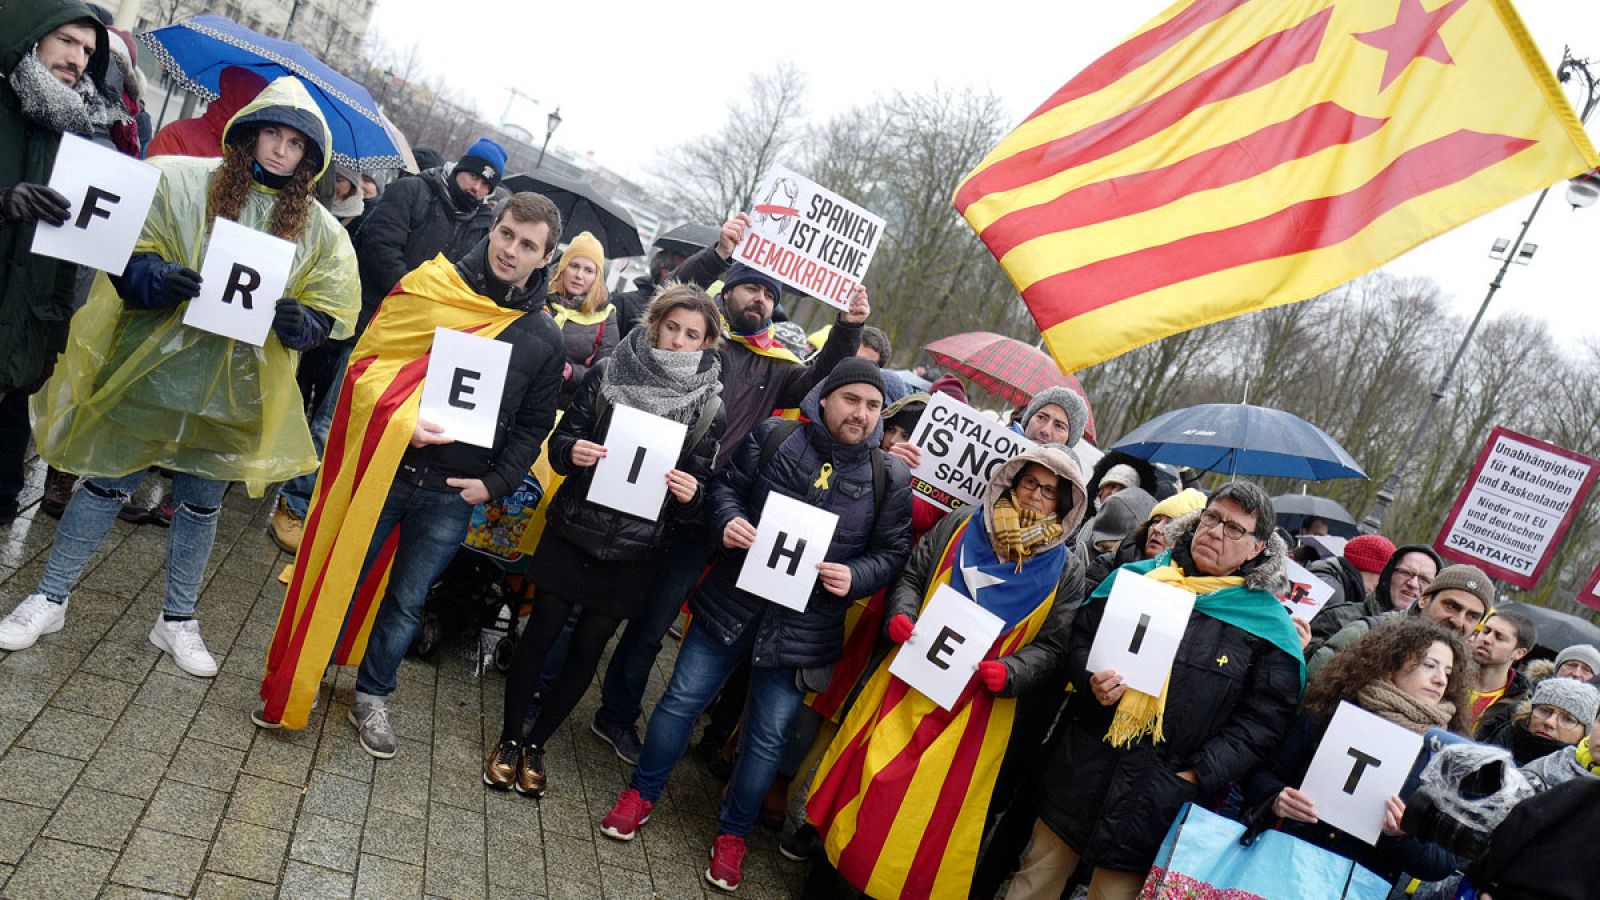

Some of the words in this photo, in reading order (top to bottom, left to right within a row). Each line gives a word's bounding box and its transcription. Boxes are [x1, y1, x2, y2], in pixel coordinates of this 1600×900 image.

[75, 186, 120, 229] F
[807, 194, 877, 248] SPANIEN
[741, 233, 857, 304] DEMOKRATIE!
[788, 220, 820, 253] IST
[817, 235, 867, 277] KEINE
[222, 263, 260, 309] R
[449, 367, 480, 409] E
[916, 423, 953, 457] IS
[932, 406, 1026, 458] CATALON
[627, 447, 646, 484] I
[1490, 459, 1508, 473] für
[1509, 467, 1573, 495] Katalonien
[1495, 443, 1585, 481] Unabhängigkeit
[911, 477, 949, 505] EEDOM
[1479, 475, 1500, 488] und
[1500, 482, 1569, 512] Baskenland!
[1468, 508, 1487, 521] und
[1489, 515, 1544, 542] deutschem
[1477, 496, 1511, 516] Nieder
[1513, 511, 1530, 522] mit
[1532, 516, 1548, 528] EU
[767, 532, 805, 576] H
[1451, 534, 1533, 571] SPARTAKIST
[1462, 519, 1537, 553] Imperialismus!
[927, 626, 965, 669] E
[1128, 613, 1151, 654] I
[1343, 747, 1381, 795] T
